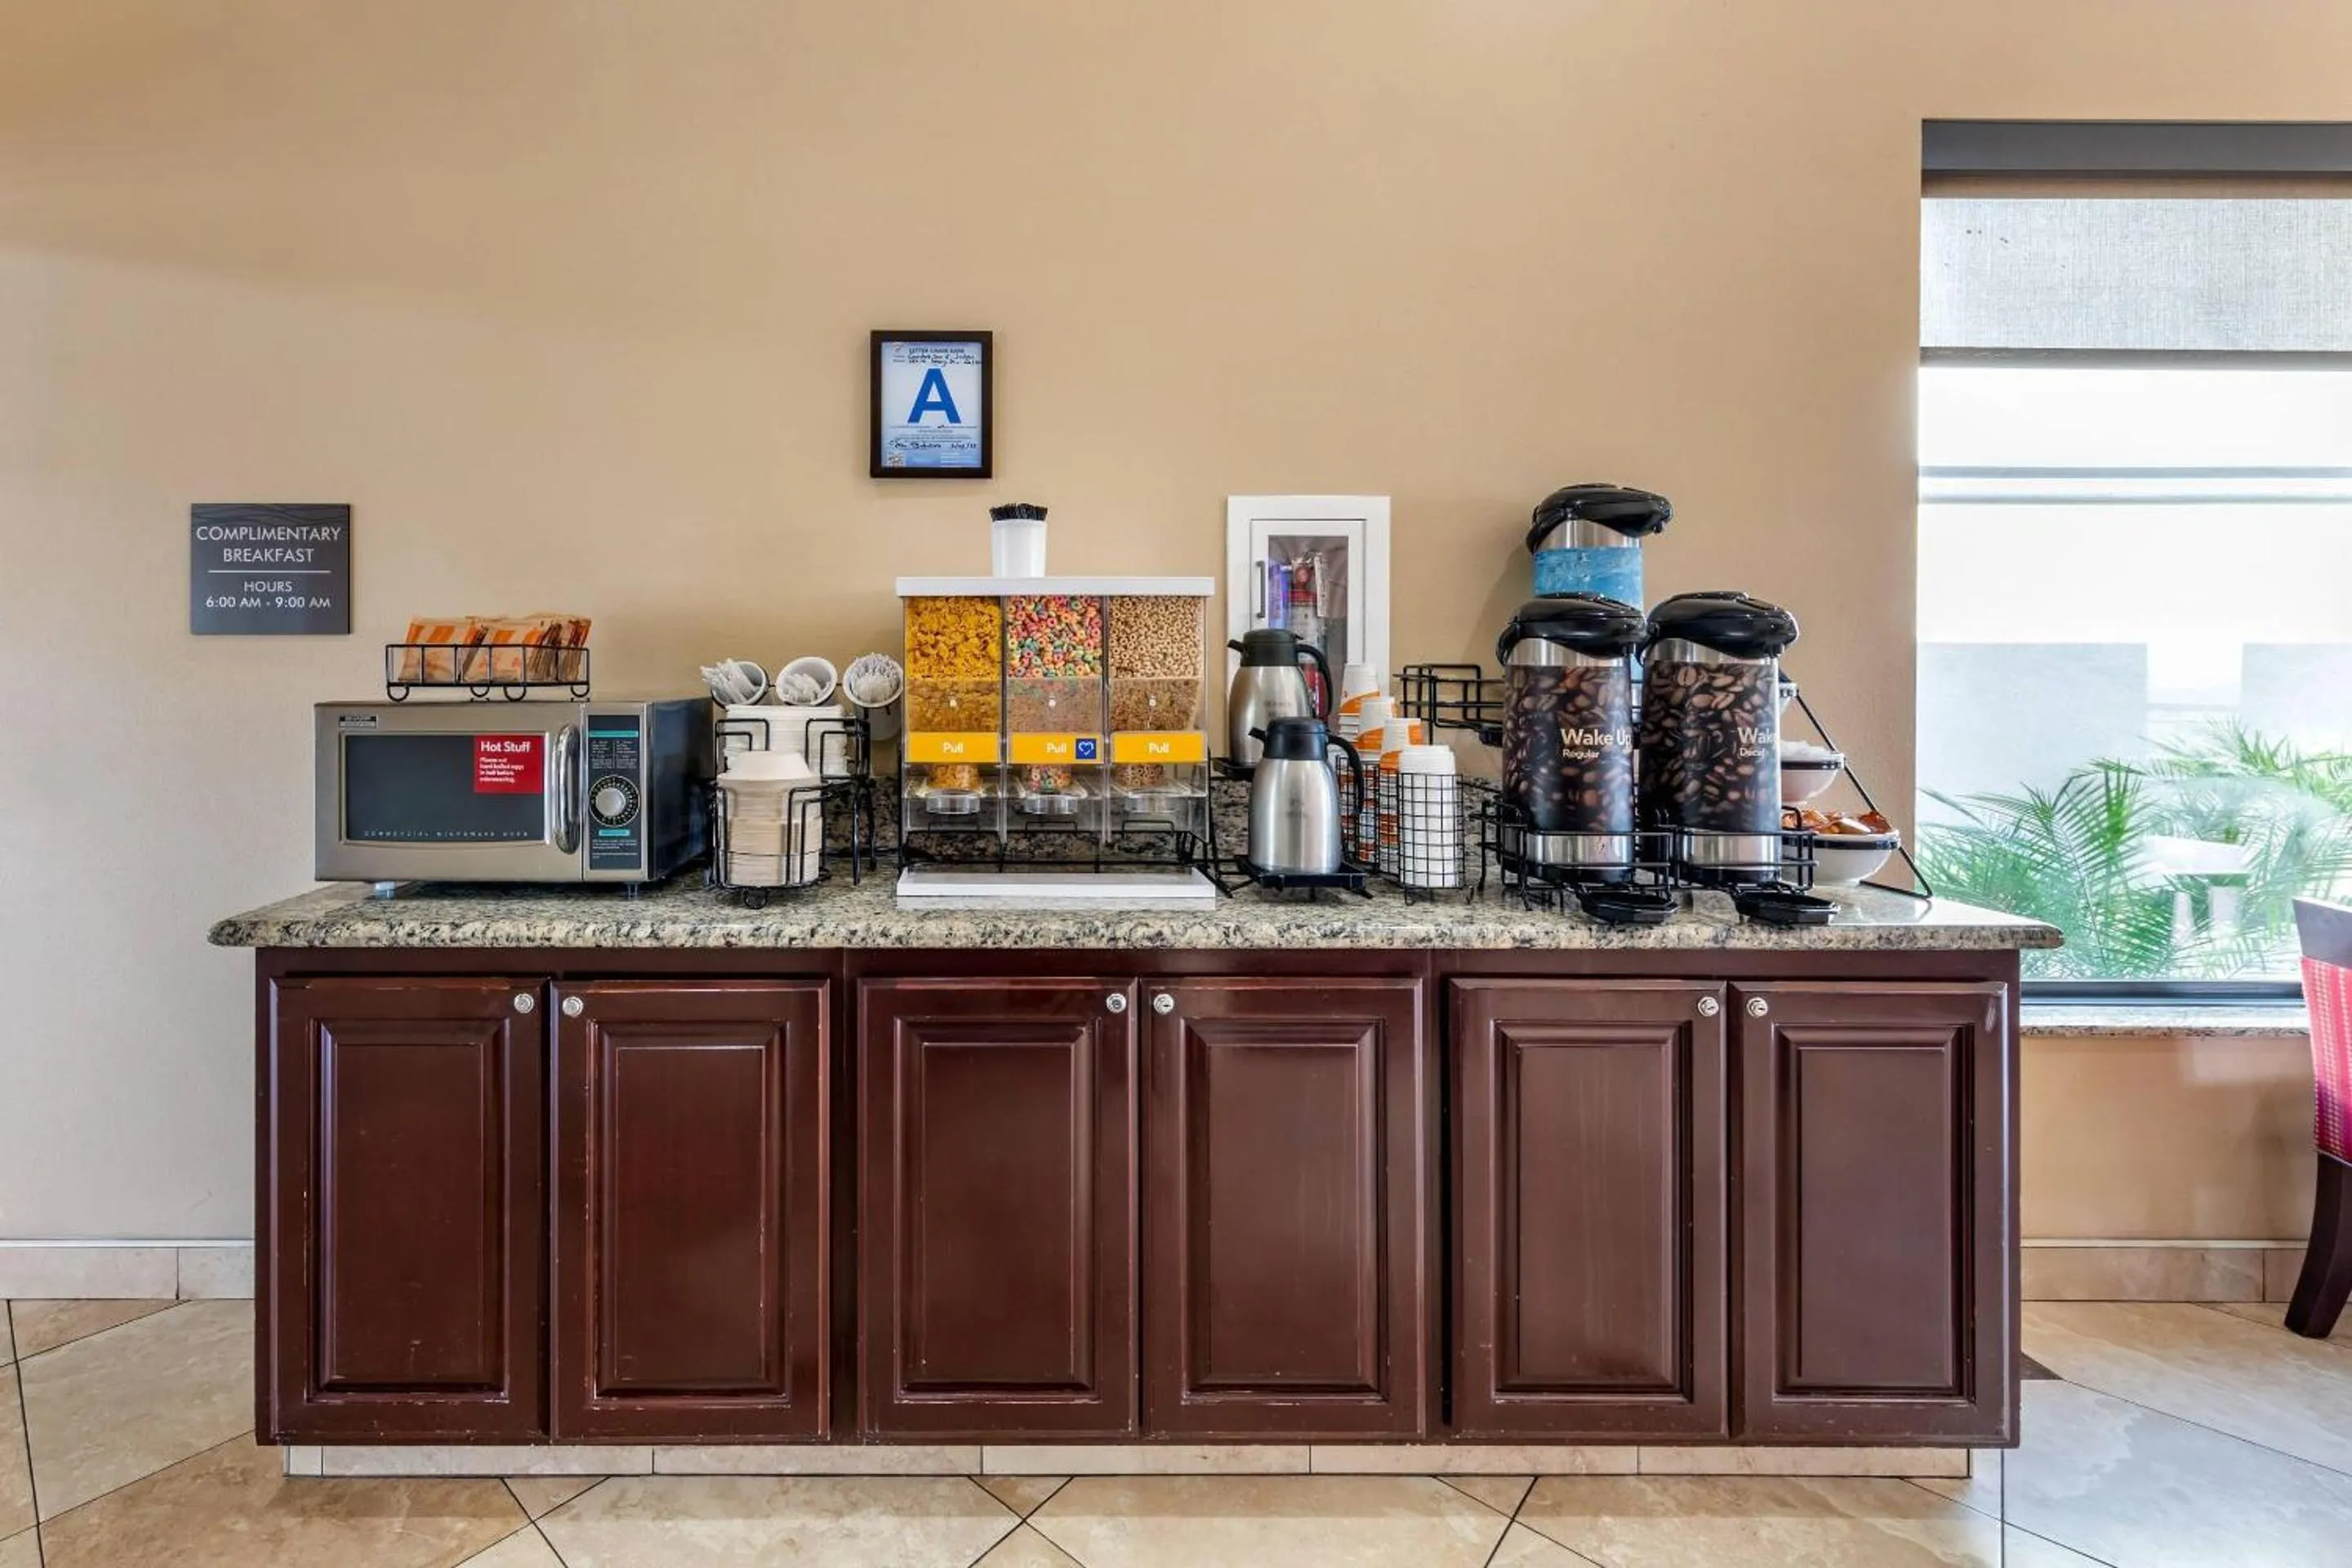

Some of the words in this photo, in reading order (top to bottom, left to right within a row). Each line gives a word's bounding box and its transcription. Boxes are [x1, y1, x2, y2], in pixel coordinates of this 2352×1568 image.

[907, 368, 962, 424] A
[196, 526, 341, 541] COMPLIMENTARY
[223, 548, 314, 563] BREAKFAST
[243, 581, 293, 592] HOURS
[206, 596, 236, 608] 6:00
[239, 597, 261, 608] AM
[274, 596, 305, 608] 9:00
[309, 597, 331, 608] AM
[1560, 728, 1614, 746] Wake
[1616, 728, 1632, 749] Up
[480, 741, 502, 752] Hot
[503, 741, 532, 752] Stuff
[943, 741, 964, 753] Pull
[1047, 742, 1067, 754] Pull
[1149, 741, 1169, 753] Pull
